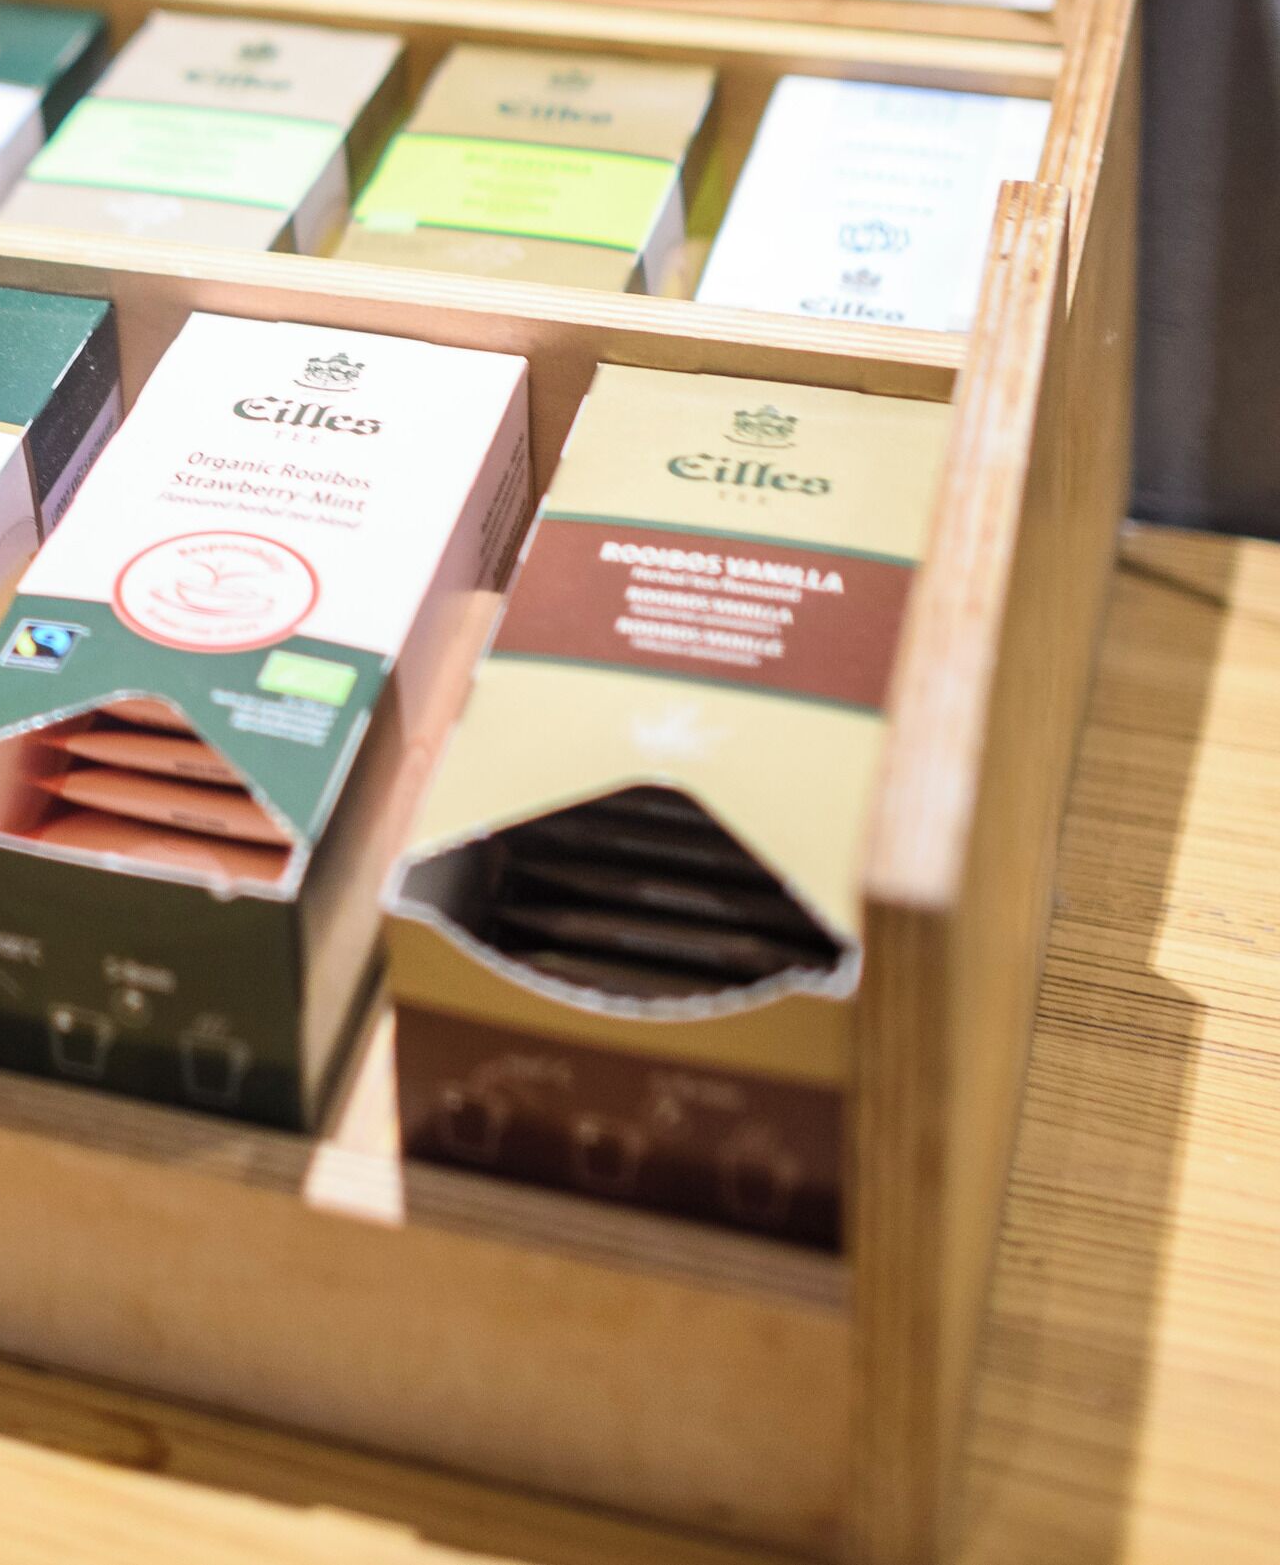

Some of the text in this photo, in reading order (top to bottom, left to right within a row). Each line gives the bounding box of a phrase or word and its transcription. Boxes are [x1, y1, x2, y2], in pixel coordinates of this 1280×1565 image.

[233, 395, 385, 436] Eilles
[187, 450, 372, 490] Organic Rooibos
[667, 453, 833, 496] Eilles
[599, 540, 844, 594] ROOIBOS VANILLA
